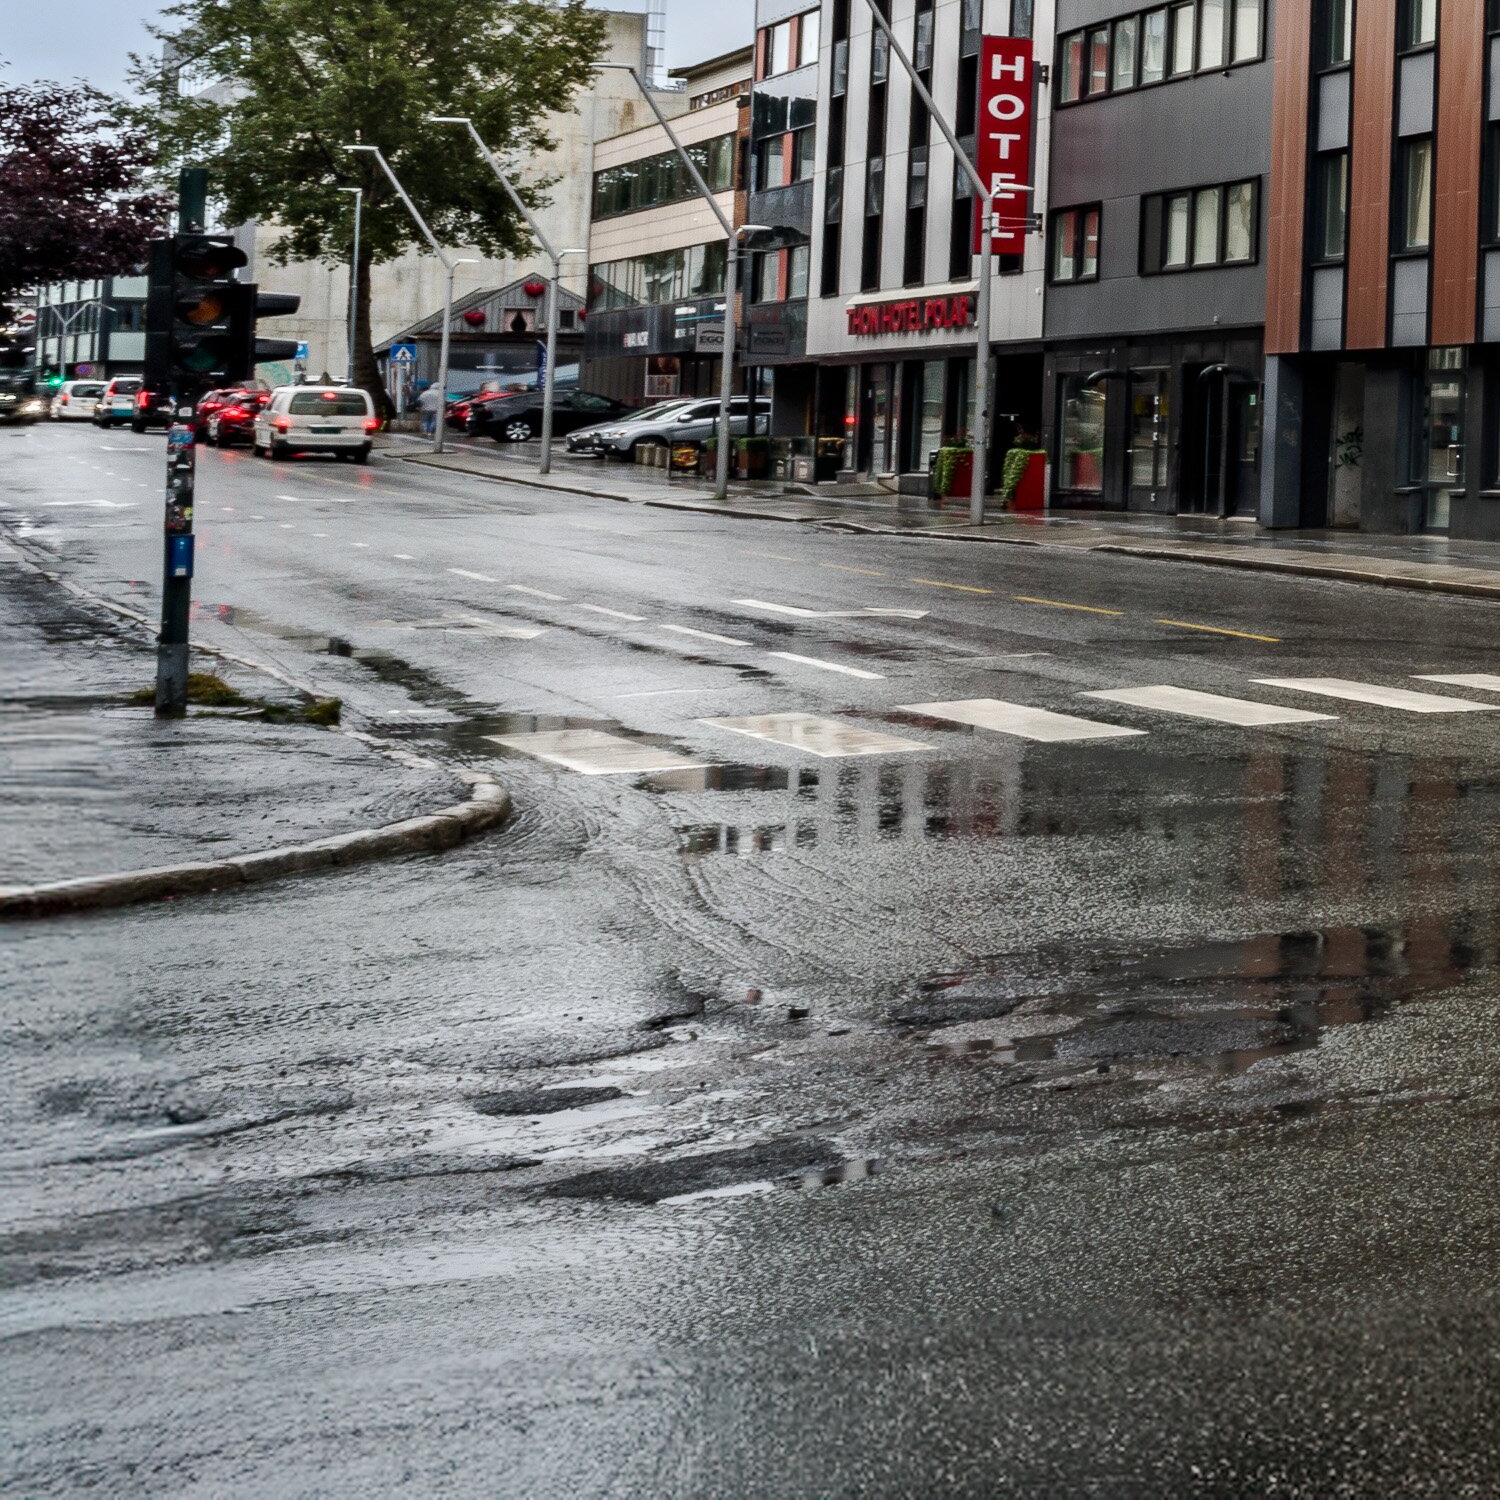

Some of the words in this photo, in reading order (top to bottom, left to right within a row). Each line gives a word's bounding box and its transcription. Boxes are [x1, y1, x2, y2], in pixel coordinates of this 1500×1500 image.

[987, 53, 1026, 239] HOTEL
[846, 305, 880, 336] THON
[882, 301, 921, 333] HOTEL
[925, 295, 970, 329] POLAR
